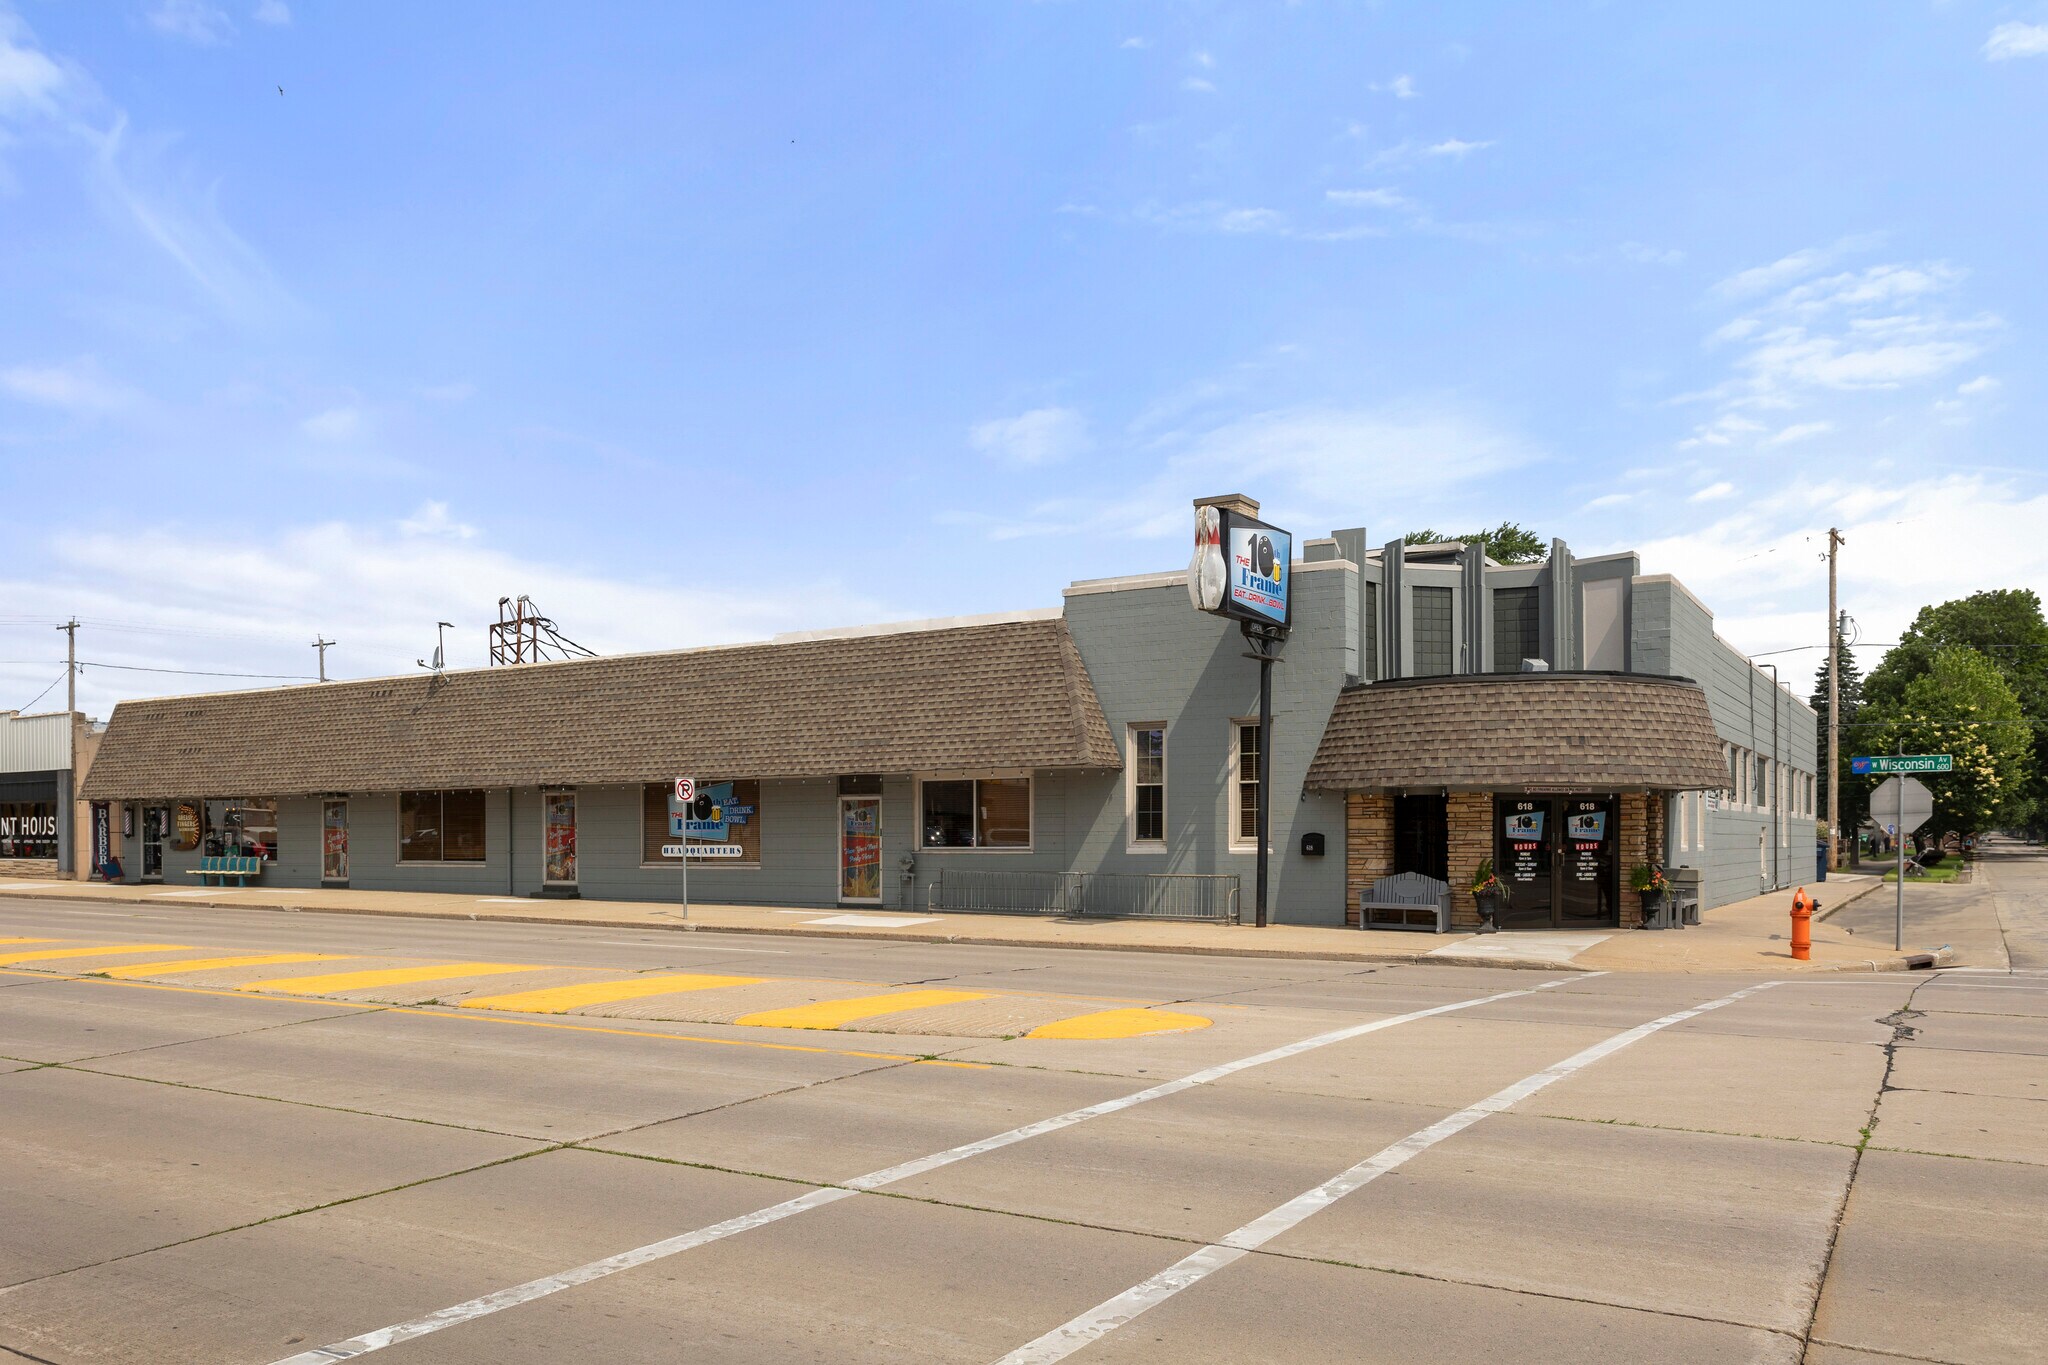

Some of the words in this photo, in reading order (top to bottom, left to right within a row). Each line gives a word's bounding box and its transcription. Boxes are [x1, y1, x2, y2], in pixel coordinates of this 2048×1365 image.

[1235, 555, 1250, 566] THE
[1241, 567, 1283, 596] Frame
[1880, 758, 1935, 770] Wisconsin
[21, 816, 59, 836] HOUS
[98, 808, 108, 865] BARBER
[1514, 843, 1537, 851] HOURS
